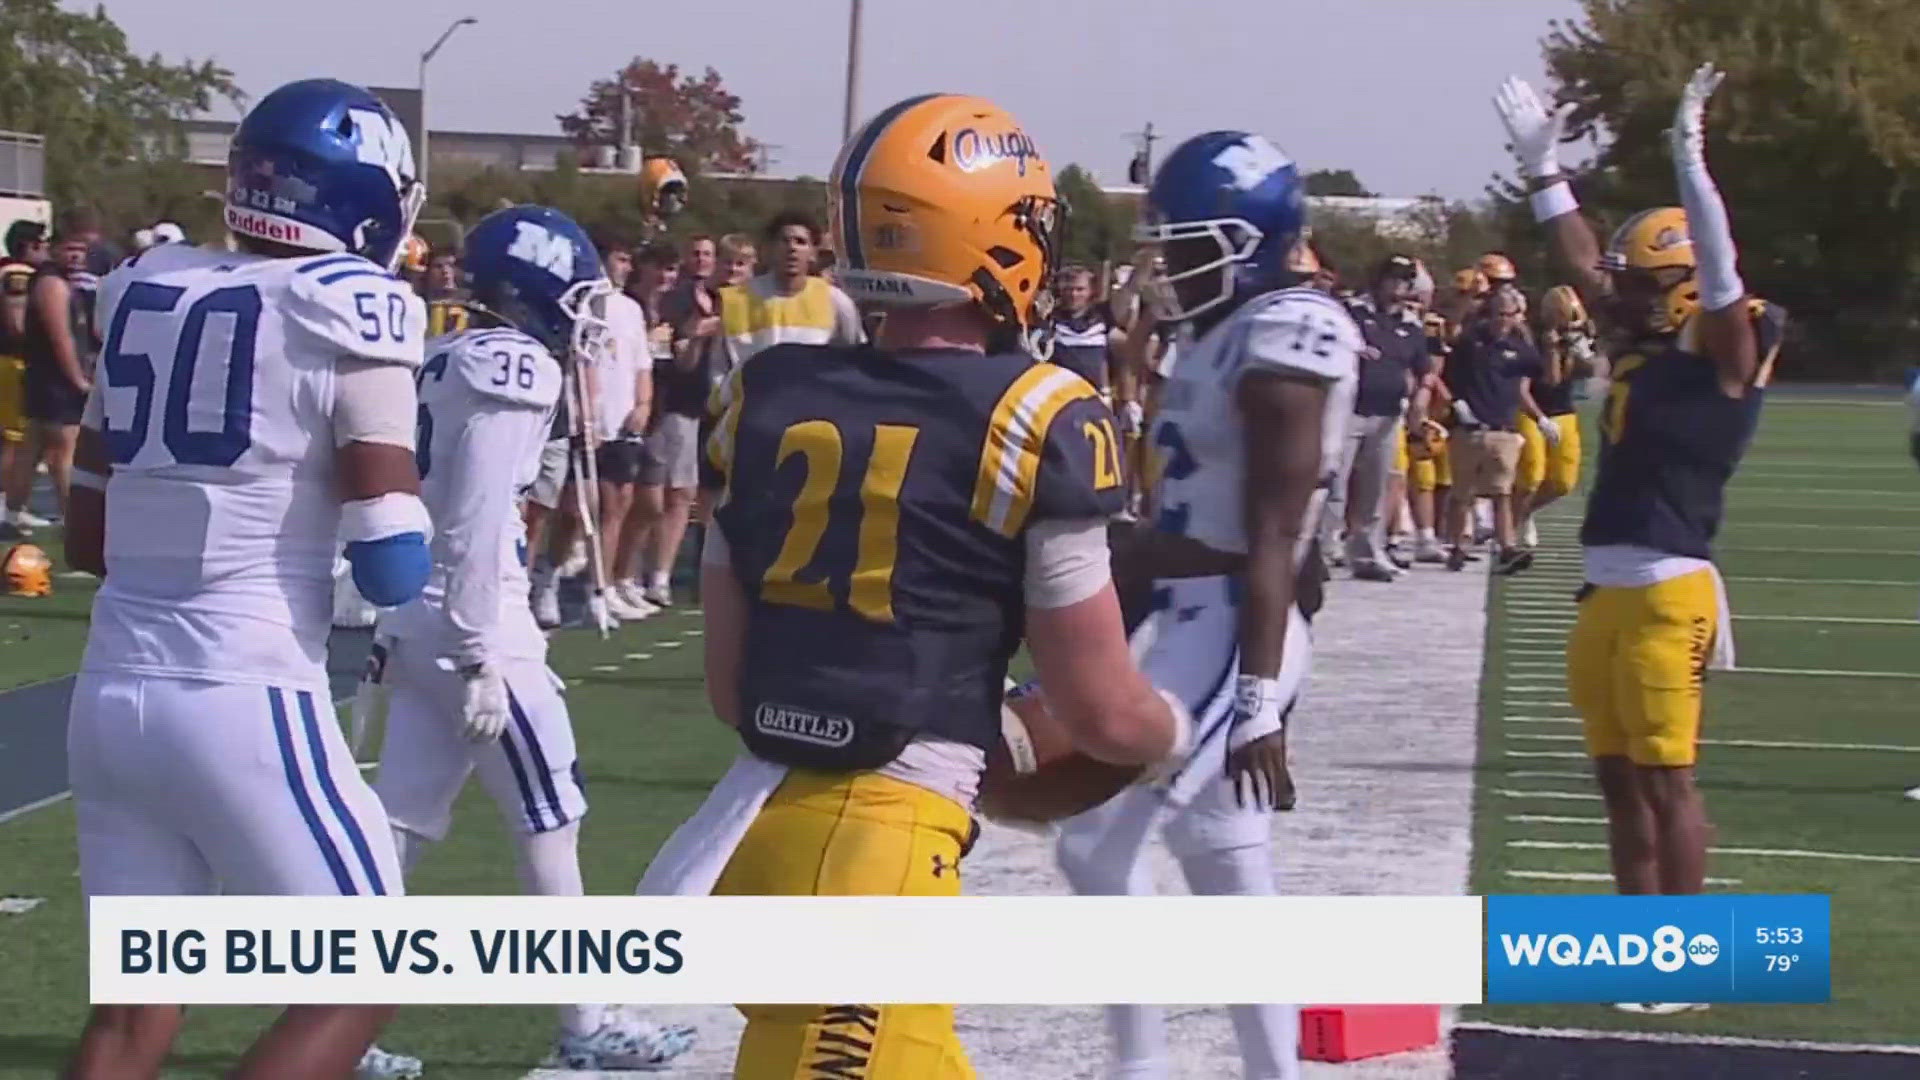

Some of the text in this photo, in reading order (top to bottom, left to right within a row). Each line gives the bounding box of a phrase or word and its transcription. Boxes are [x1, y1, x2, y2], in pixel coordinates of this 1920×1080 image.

[354, 292, 406, 342] 50
[105, 281, 262, 467] 50
[491, 351, 535, 389] 36
[1083, 418, 1122, 490] 21
[760, 419, 920, 623] 21
[763, 707, 842, 739] BATTLE
